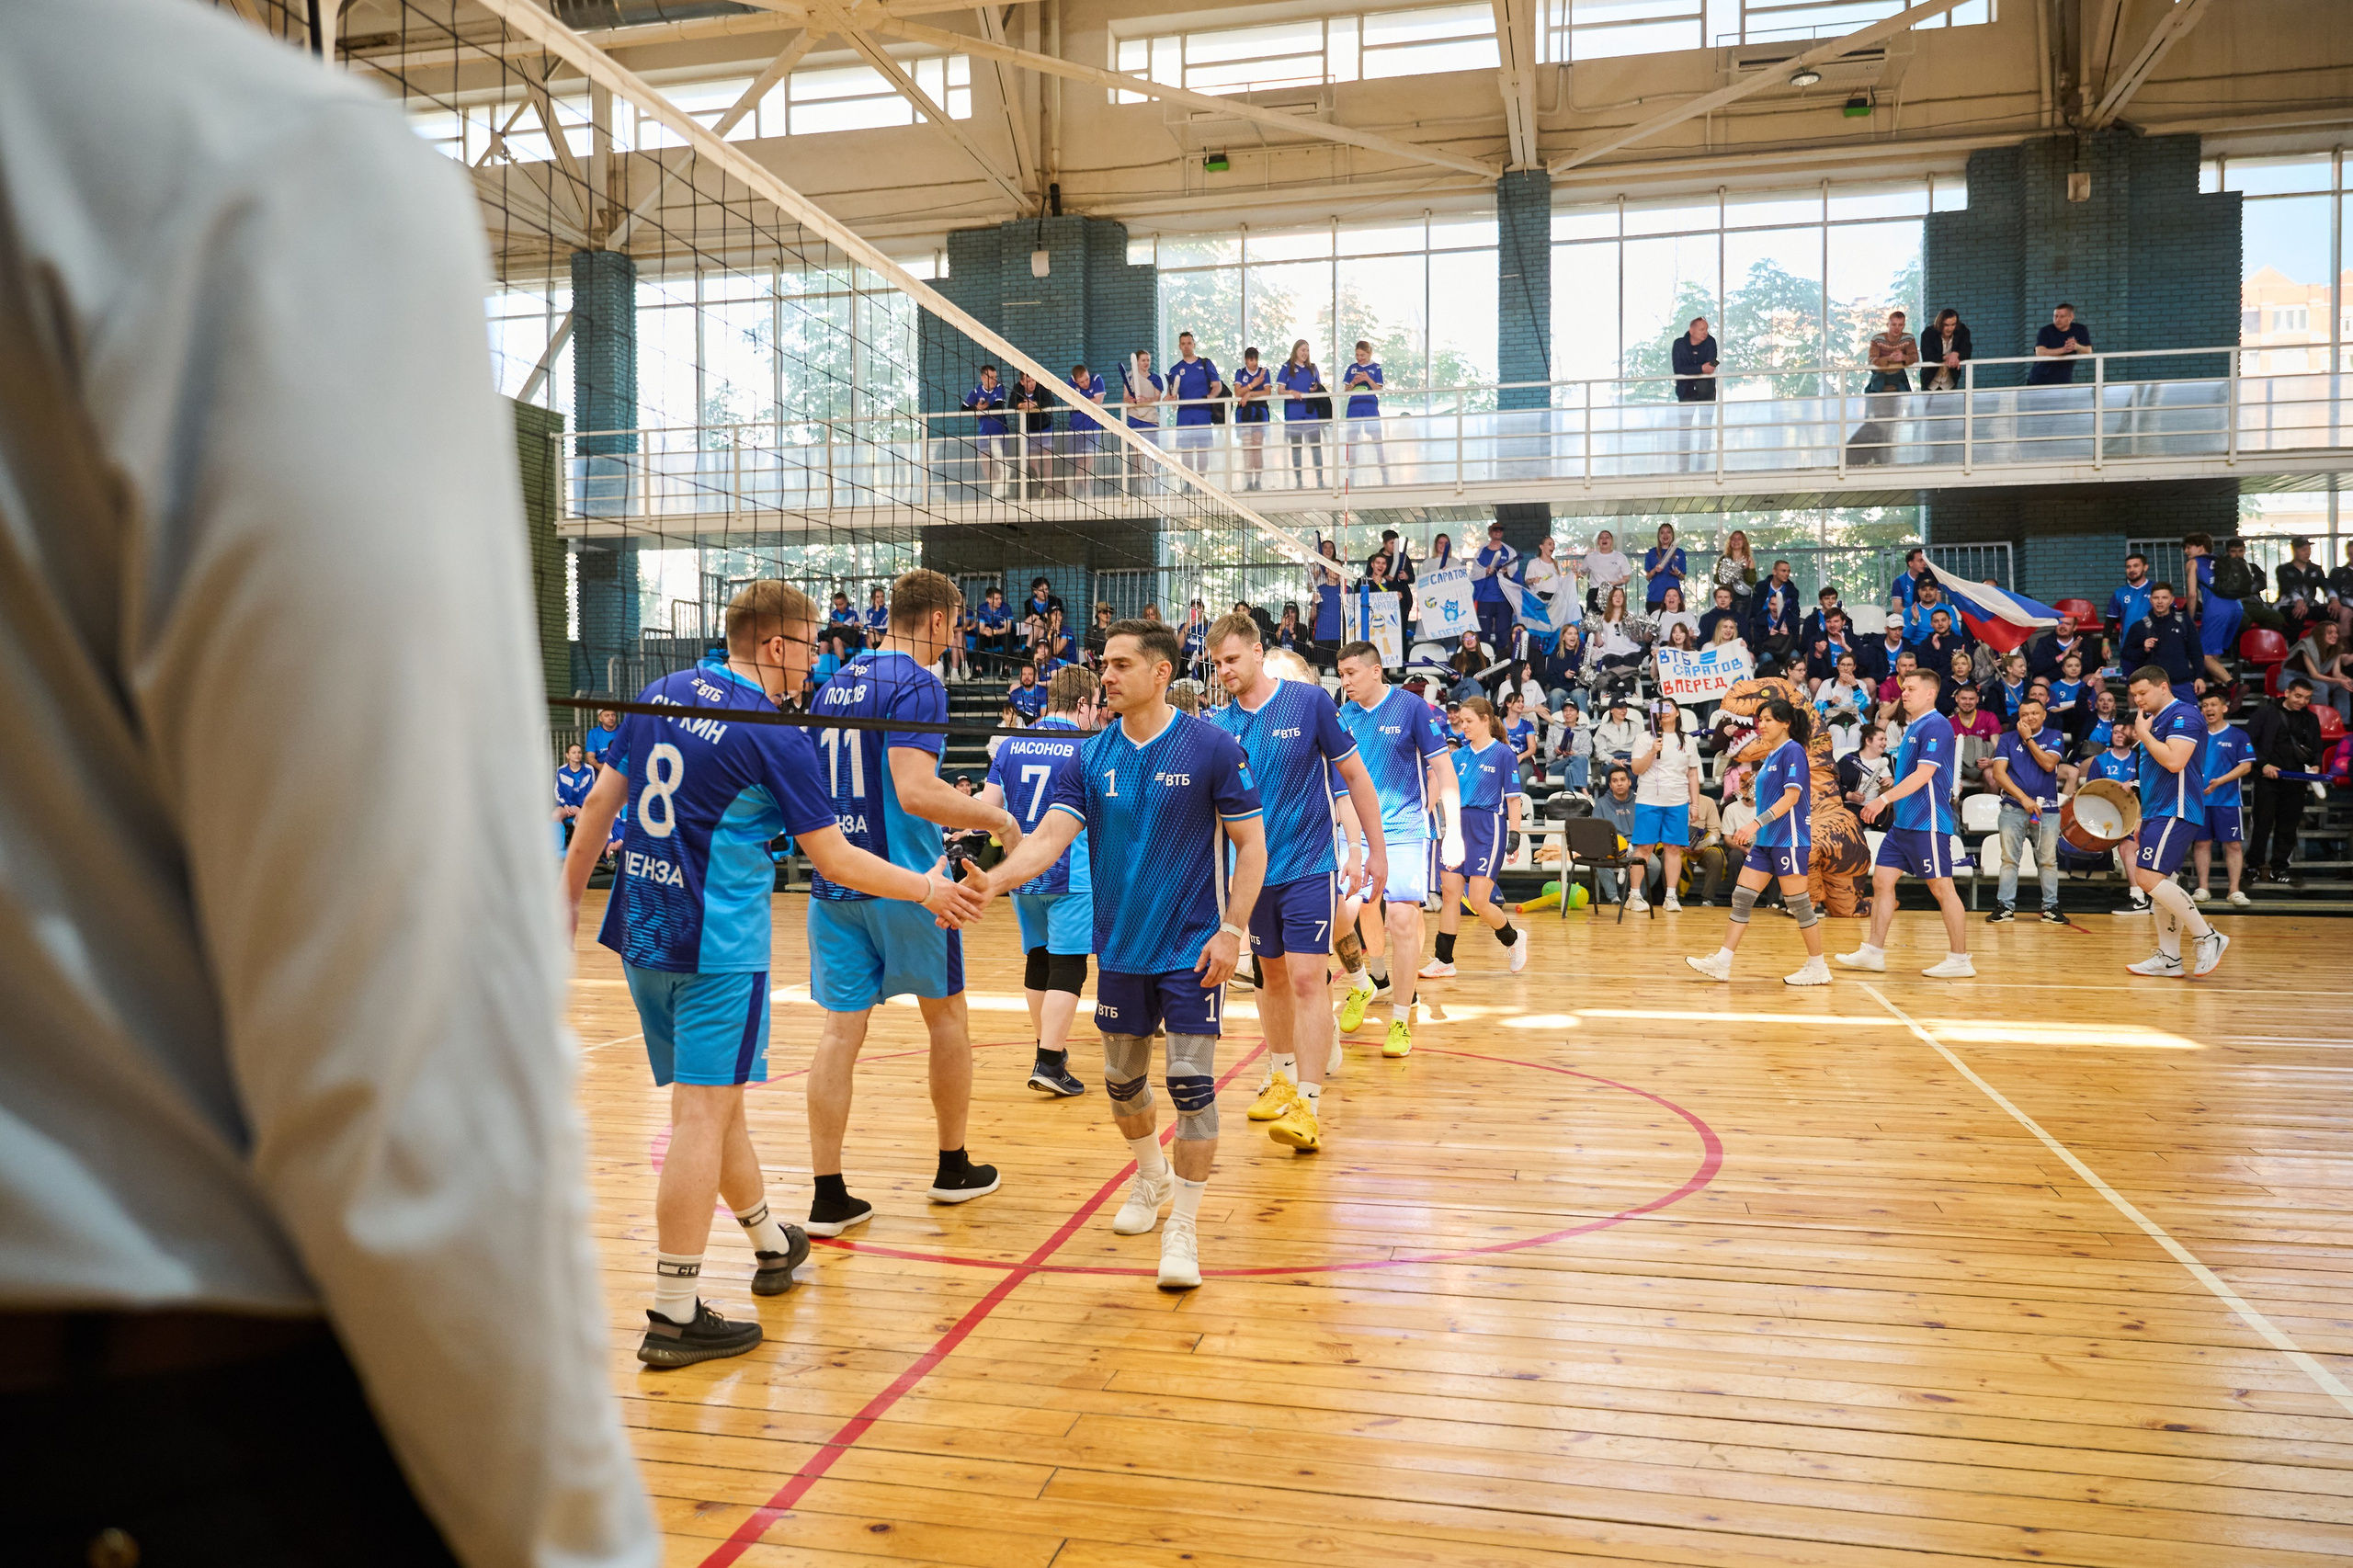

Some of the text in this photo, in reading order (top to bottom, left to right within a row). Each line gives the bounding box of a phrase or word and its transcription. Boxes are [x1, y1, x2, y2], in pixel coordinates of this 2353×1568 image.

[1430, 569, 1468, 585] САРАТОВ
[1372, 600, 1399, 611] АРАТОВ
[2123, 595, 2131, 604] 8
[1658, 649, 1691, 666] ВТБ
[1673, 657, 1744, 678] САРАТОВ
[697, 683, 724, 703] ВТБ
[1663, 676, 1728, 696] ВПЕРЕД
[824, 684, 868, 706] ПОПОВ
[2059, 690, 2066, 699] 9
[1280, 727, 1301, 739] ВТБ
[1385, 725, 1401, 734] ВТБ
[1010, 741, 1074, 757] НАСОНОВ
[820, 727, 866, 798] 11
[1458, 762, 1467, 776] 2
[1483, 765, 1495, 774] ВТБ
[2105, 765, 2119, 776] 12
[1104, 768, 1119, 797] 1
[1165, 772, 1190, 787] ВТБ
[637, 742, 684, 838] 8
[1020, 764, 1051, 823] 7
[835, 814, 869, 834] НЗА
[2231, 826, 2239, 837] 7
[2142, 846, 2154, 861] 8
[1477, 857, 1487, 871] 2
[1780, 856, 1790, 870] 9
[1923, 858, 1932, 873] 5
[1409, 875, 1421, 892] 4
[1314, 920, 1328, 942] 7
[1097, 1003, 1119, 1019] ВТБ
[1204, 993, 1217, 1022] 1
